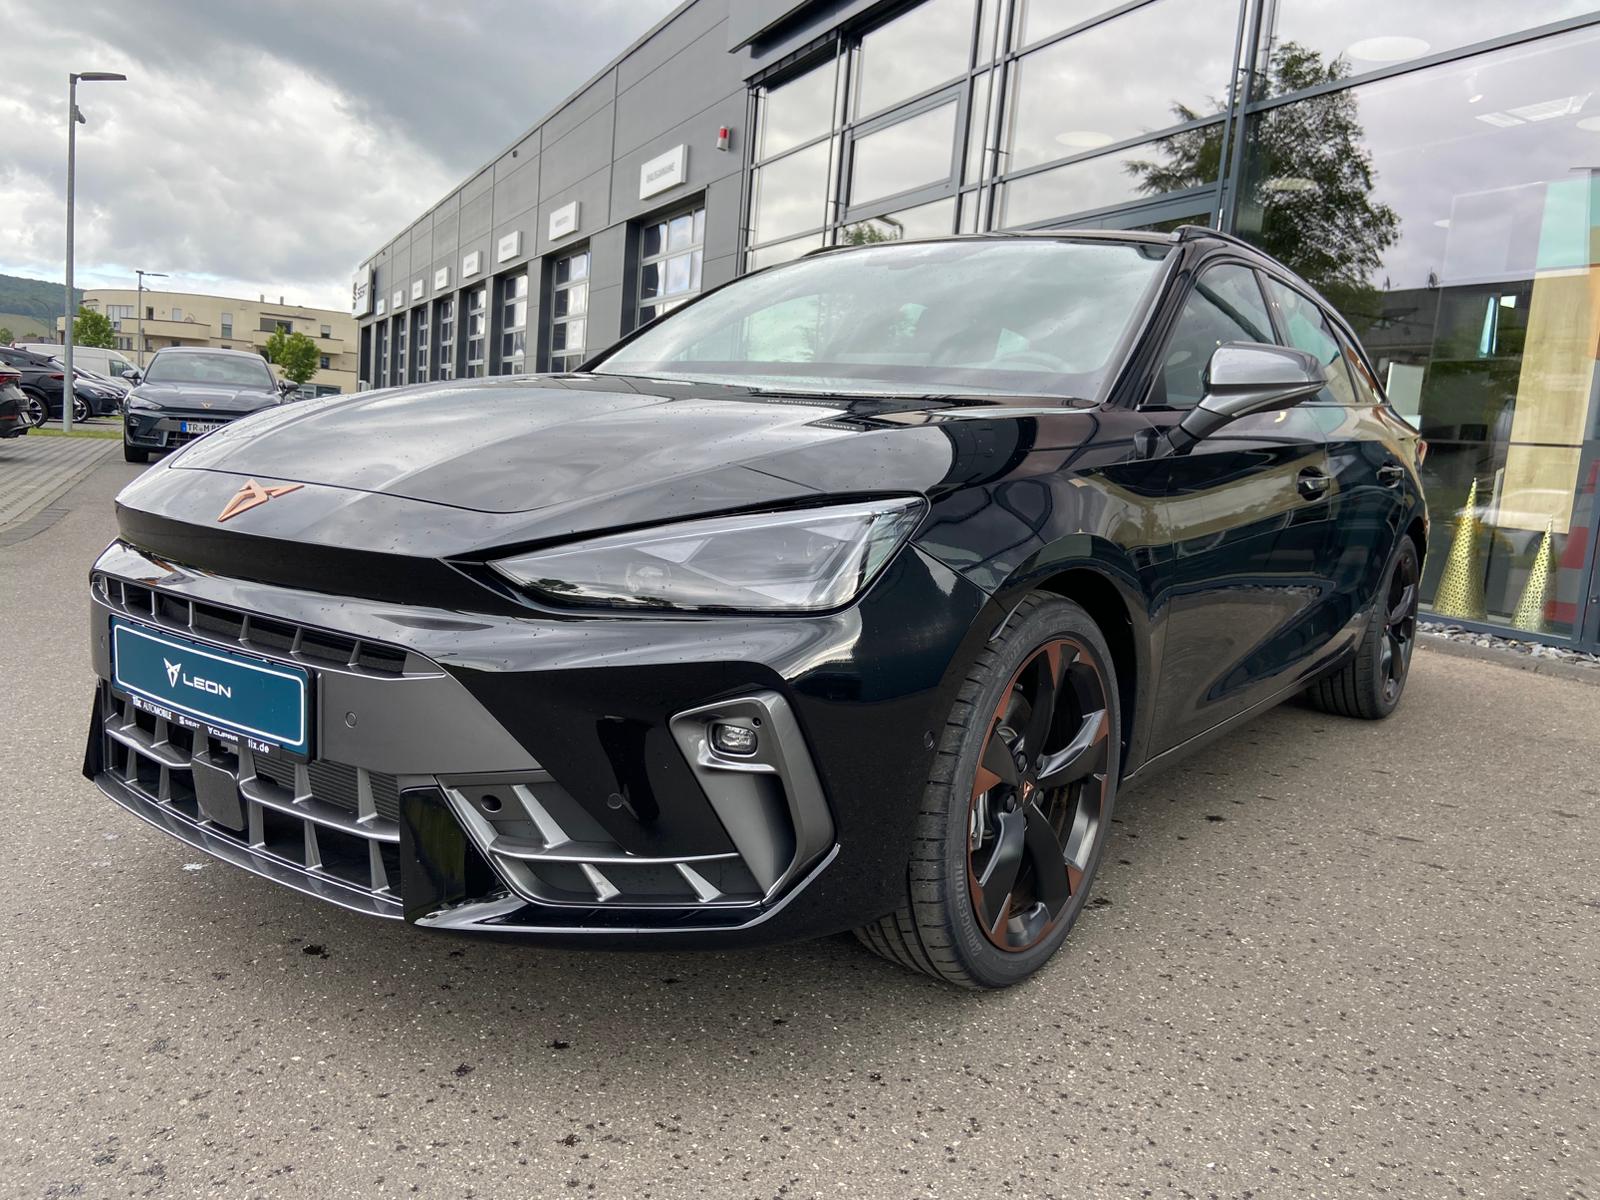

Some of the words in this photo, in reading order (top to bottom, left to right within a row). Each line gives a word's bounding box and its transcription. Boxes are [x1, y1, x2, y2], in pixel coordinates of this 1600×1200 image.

[188, 423, 198, 432] TR
[182, 672, 232, 699] LEON
[954, 853, 983, 957] BRIDGESTONE
